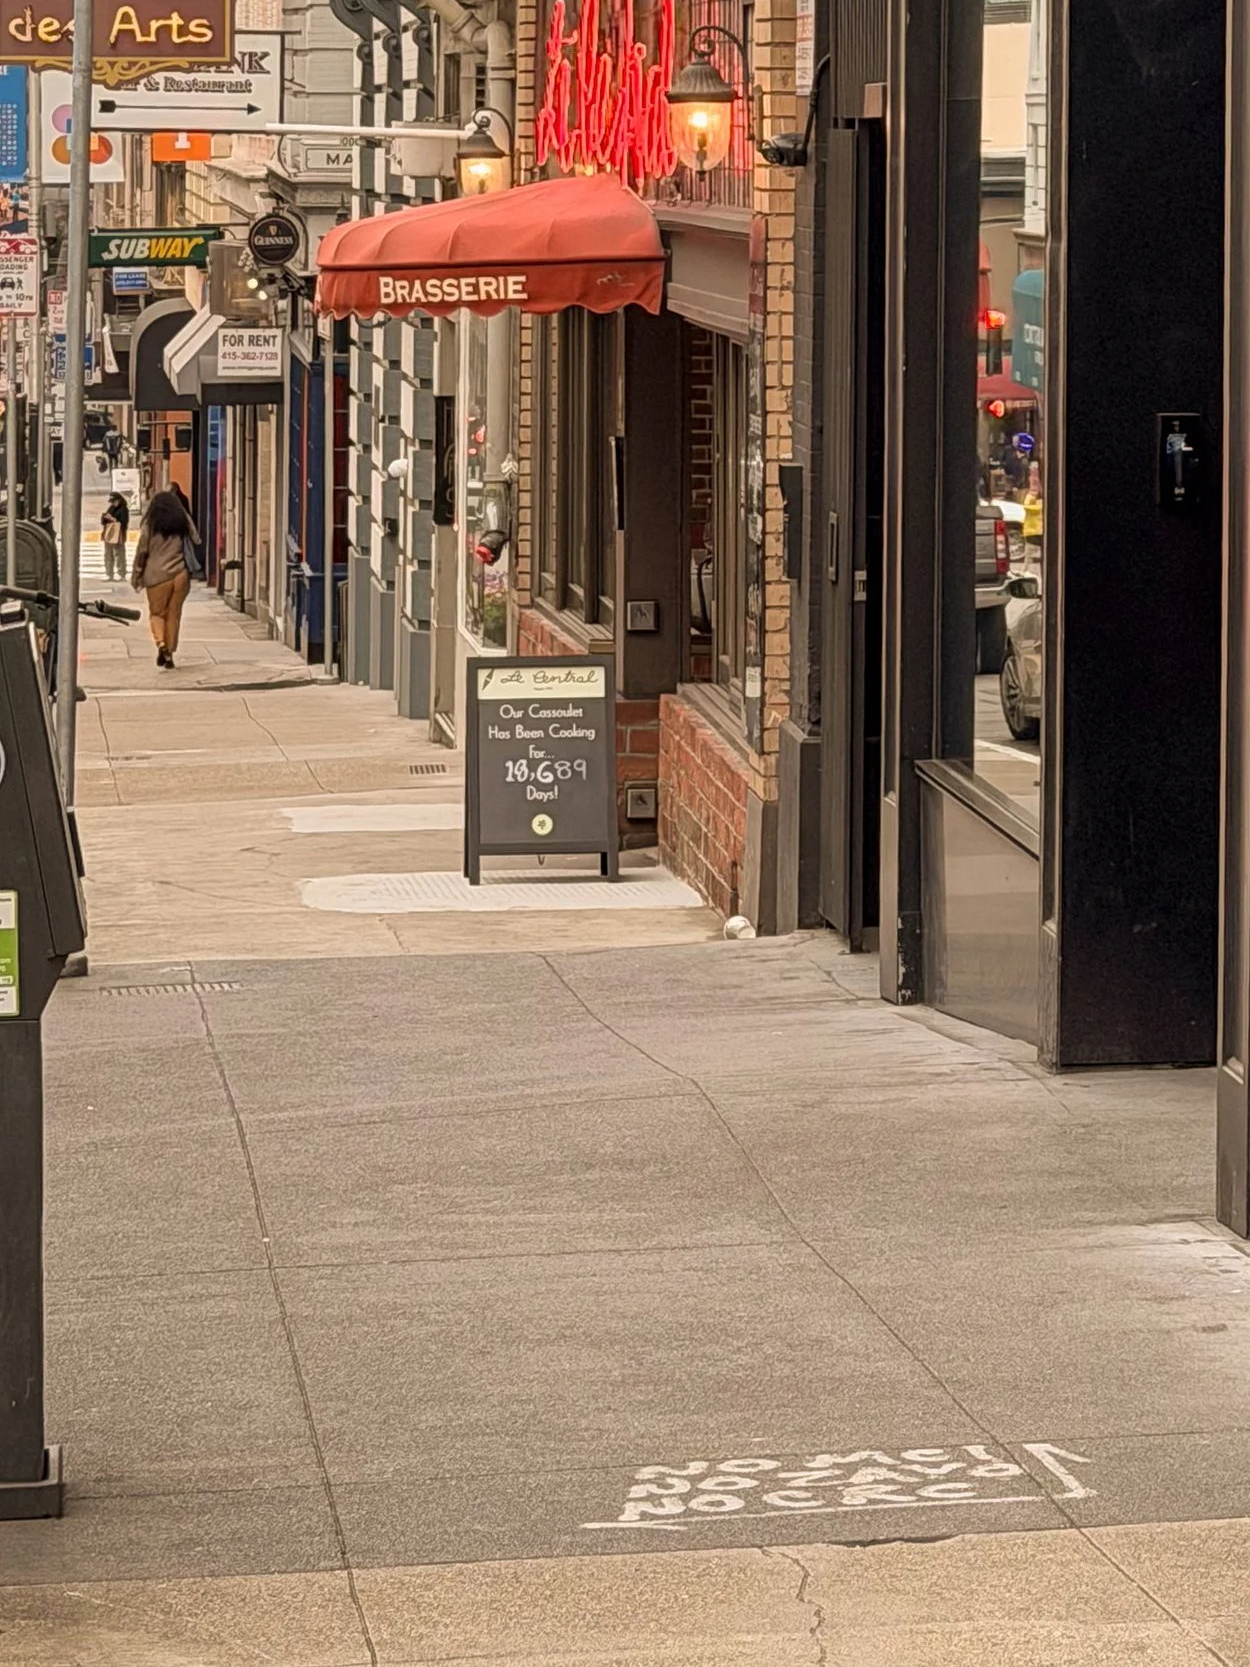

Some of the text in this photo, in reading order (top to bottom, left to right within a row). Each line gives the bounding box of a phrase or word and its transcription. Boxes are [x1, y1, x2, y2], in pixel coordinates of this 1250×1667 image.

[109, 5, 214, 48] Arts
[163, 76, 253, 94] Restaurant
[101, 237, 205, 261] SUBWAY
[378, 275, 528, 305] BRASSERIE
[222, 334, 278, 347] FOR RENT
[500, 669, 599, 684] Le Central
[500, 703, 583, 718] Our Cassoulet
[488, 724, 596, 741] Has Been Cooking
[526, 785, 558, 802] Days!
